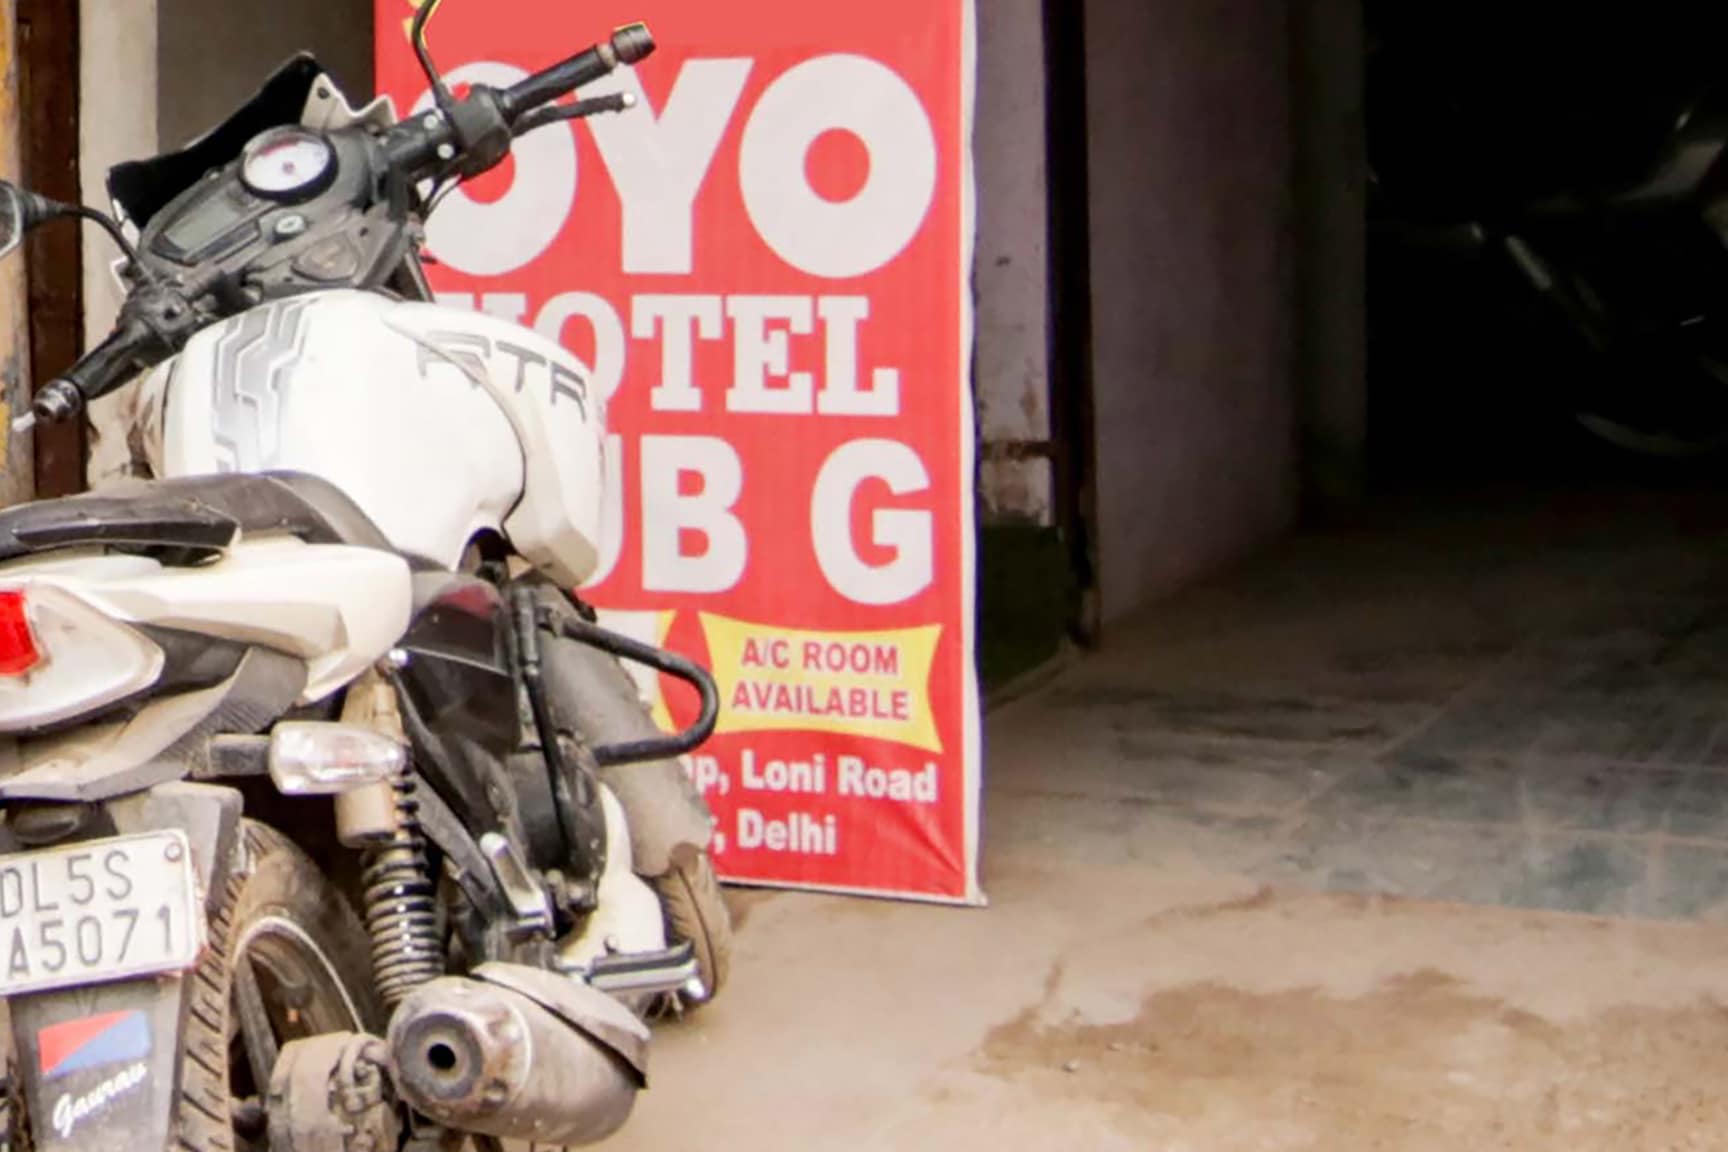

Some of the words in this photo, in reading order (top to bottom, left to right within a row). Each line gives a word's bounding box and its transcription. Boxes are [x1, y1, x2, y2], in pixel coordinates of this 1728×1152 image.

[407, 53, 937, 279] OYO
[810, 437, 934, 605] G
[802, 641, 899, 674] ROOM
[731, 681, 911, 721] AVAILABLE
[741, 749, 825, 794] Loni
[838, 755, 937, 803] Road
[737, 808, 837, 855] Delhi
[0, 849, 133, 919] DL5S
[8, 904, 172, 980] A5071
